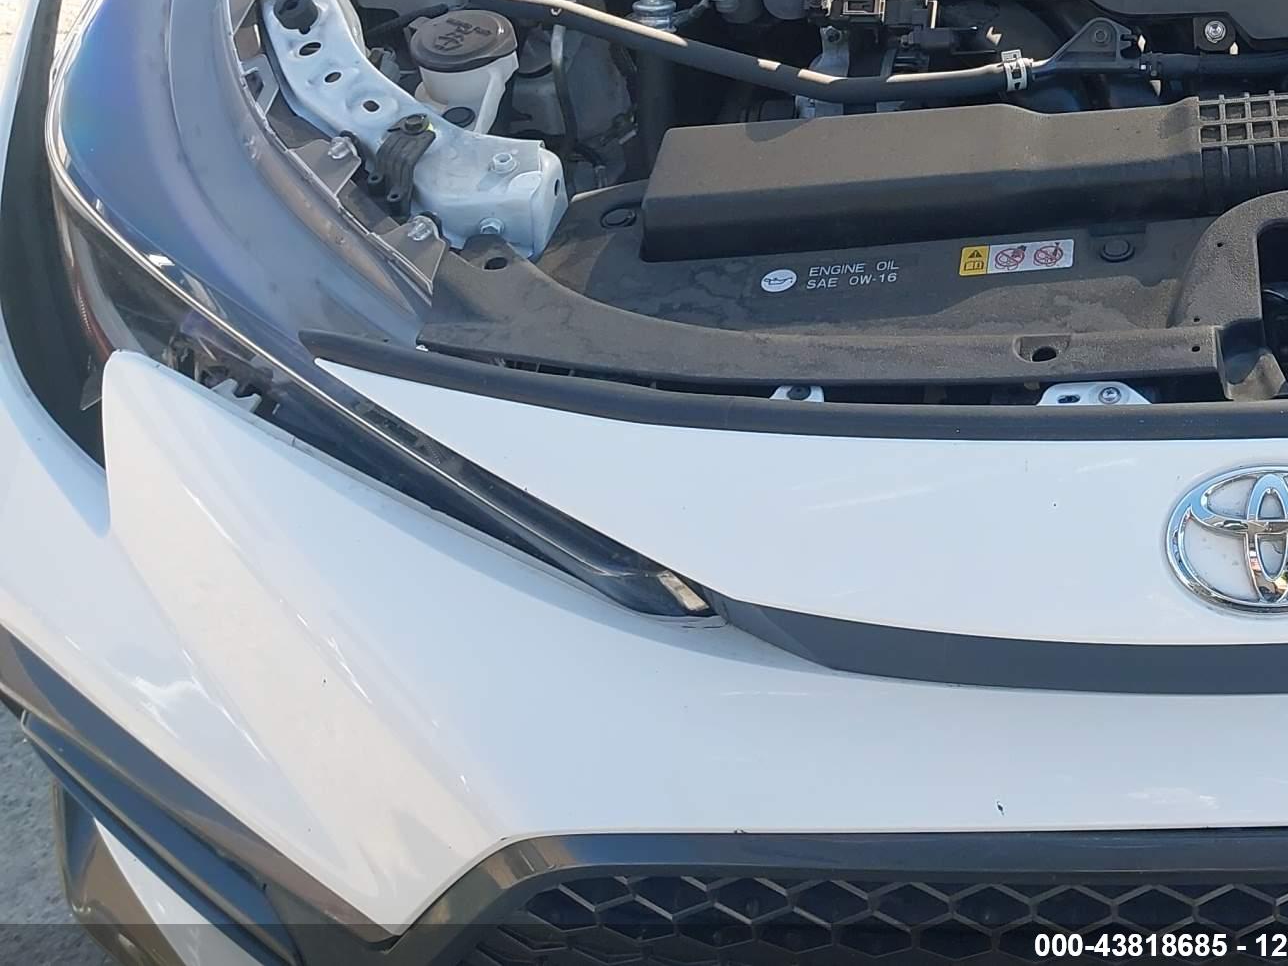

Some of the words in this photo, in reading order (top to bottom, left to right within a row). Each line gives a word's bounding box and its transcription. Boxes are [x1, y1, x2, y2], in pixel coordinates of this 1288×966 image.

[808, 263, 867, 277] ENGINE
[876, 260, 900, 271] OIL
[806, 277, 839, 289] SAE
